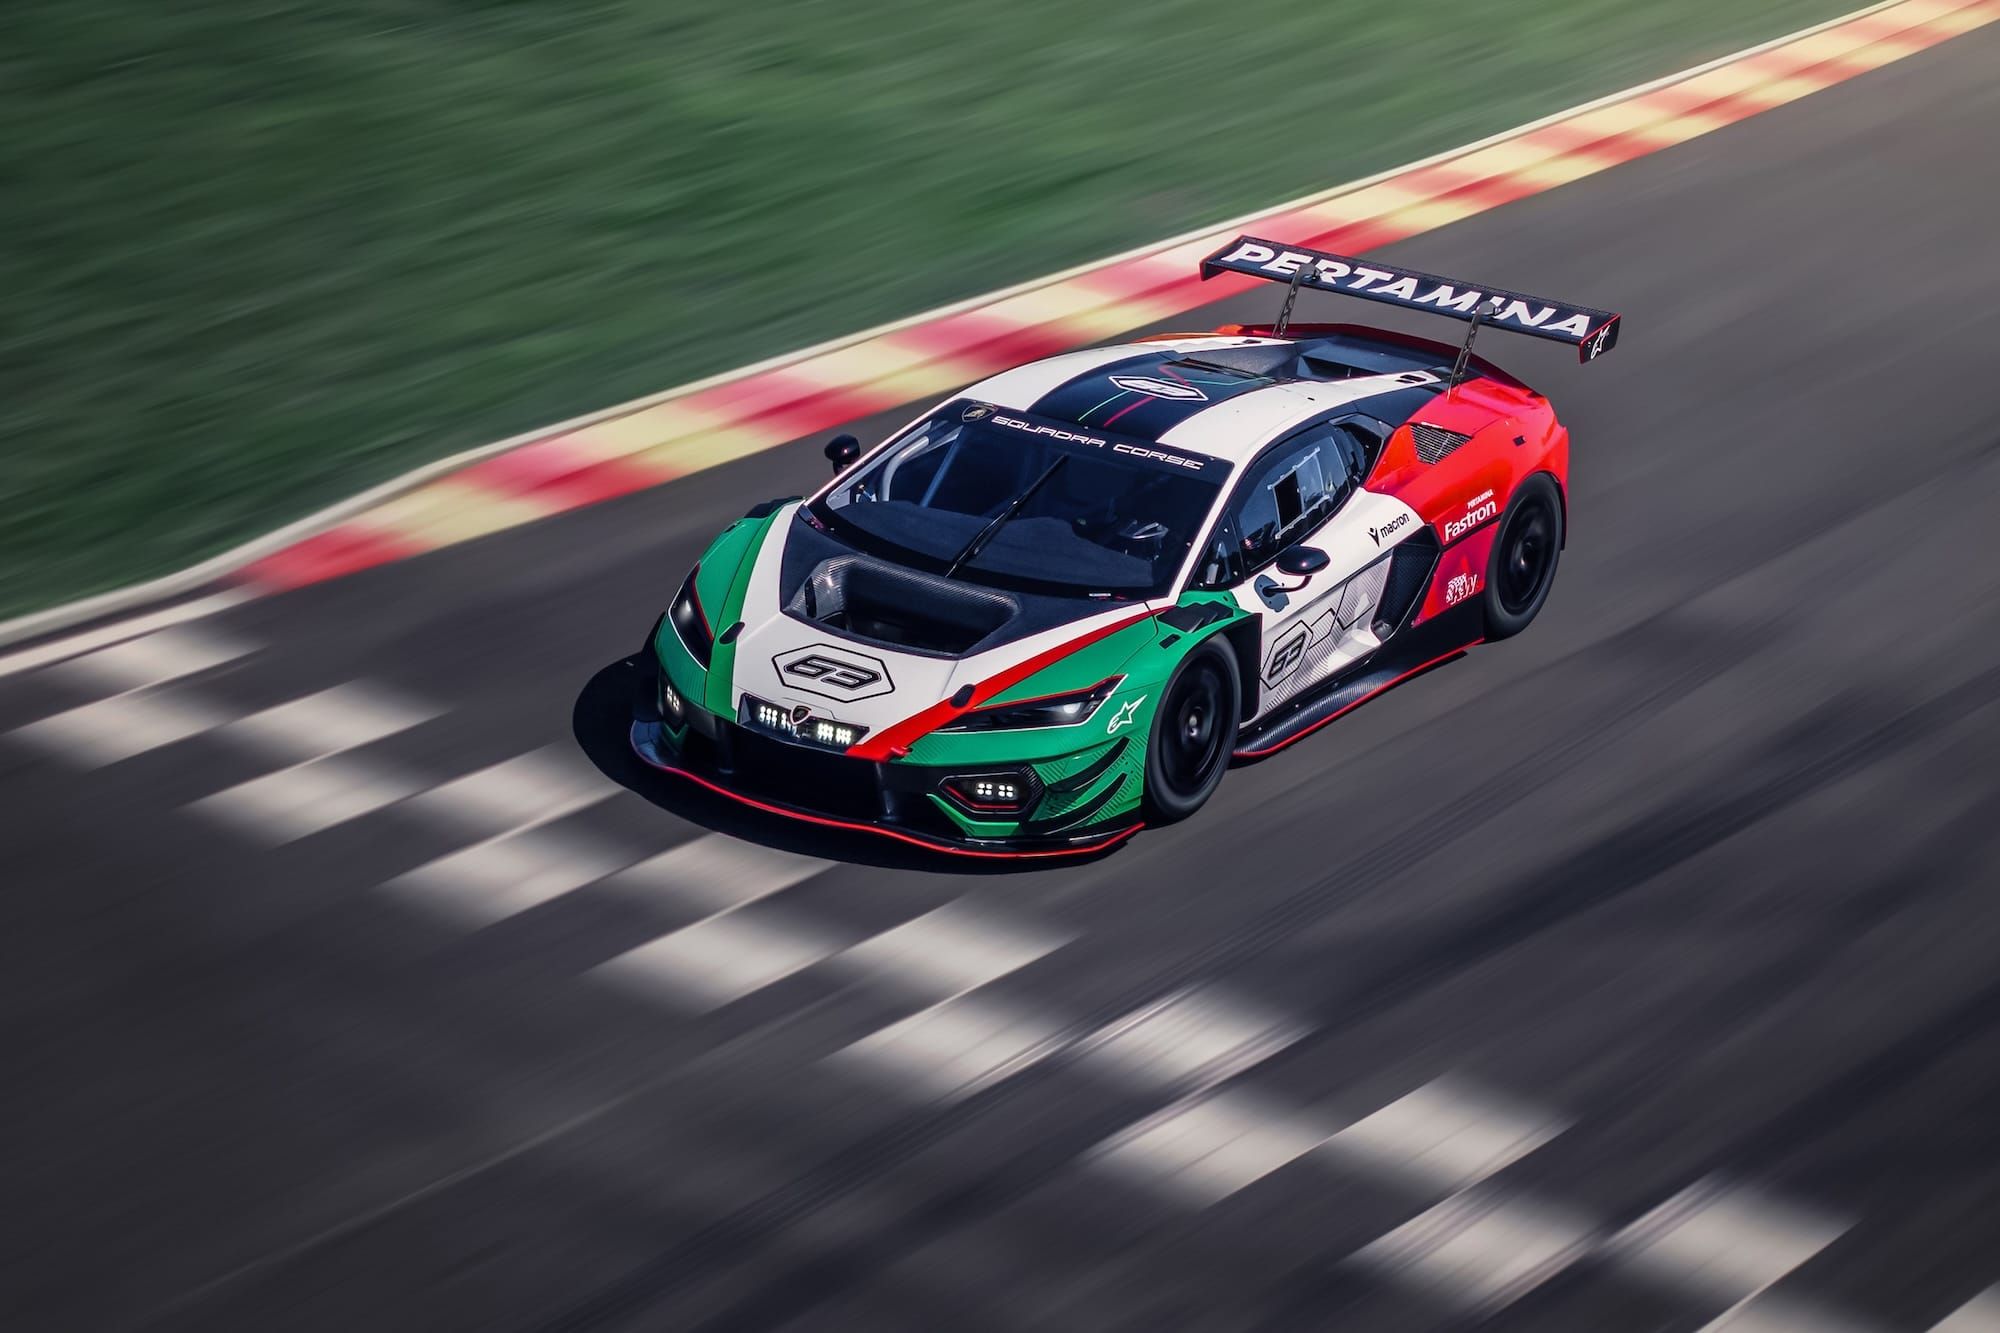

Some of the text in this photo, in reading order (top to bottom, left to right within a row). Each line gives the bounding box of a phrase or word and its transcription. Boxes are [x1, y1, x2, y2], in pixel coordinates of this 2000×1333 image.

[991, 415, 1204, 470] SQUADRA CORSE
[1380, 511, 1411, 539] macron
[1445, 500, 1497, 542] Fastron
[783, 653, 882, 691] 63
[1267, 630, 1307, 680] 63
